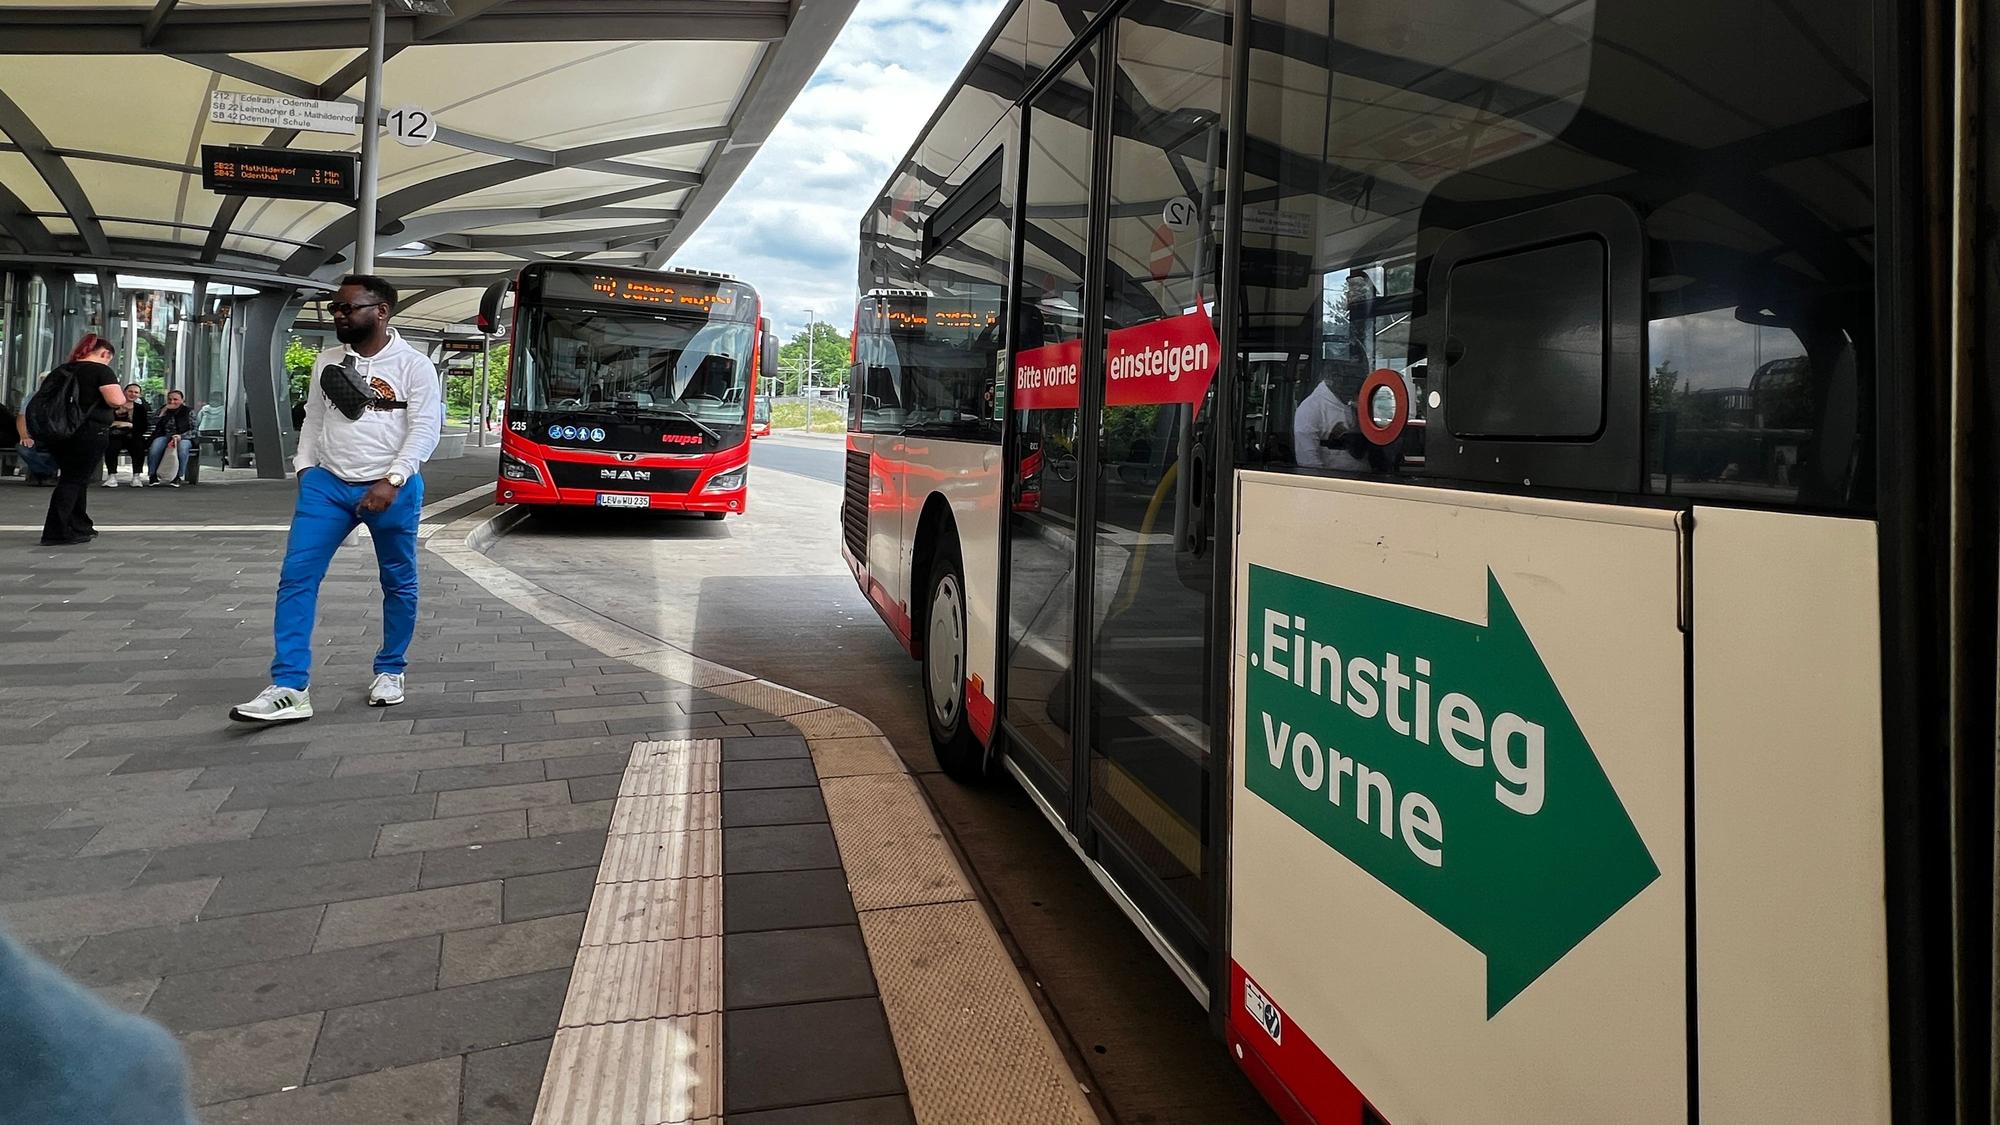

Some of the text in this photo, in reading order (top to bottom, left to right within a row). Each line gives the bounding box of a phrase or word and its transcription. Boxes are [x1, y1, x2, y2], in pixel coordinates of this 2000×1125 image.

[213, 91, 230, 100] 212
[282, 98, 319, 109] Odenthal
[212, 102, 226, 110] SB
[227, 103, 239, 112] 22
[240, 105, 287, 116] Leimbacher
[304, 111, 354, 122] Mathildenhof
[212, 111, 225, 119] SB
[227, 112, 238, 120] 42
[282, 118, 311, 127] Schule
[391, 110, 428, 138] 12
[214, 162, 235, 170] SB22
[241, 164, 297, 176] Mathildenhof
[324, 170, 340, 178] Min
[241, 171, 279, 181] Odenthal
[311, 176, 320, 184] 13
[324, 177, 340, 185] Min
[1017, 340, 1209, 390] Bitte vorne einsteigen
[511, 421, 527, 430] 235
[662, 432, 703, 446] wupsi
[600, 469, 651, 480] MAN
[602, 495, 618, 504] LEV
[634, 496, 648, 506] 235
[1263, 608, 1545, 816] Einstieg
[1262, 711, 1443, 867] vorne
